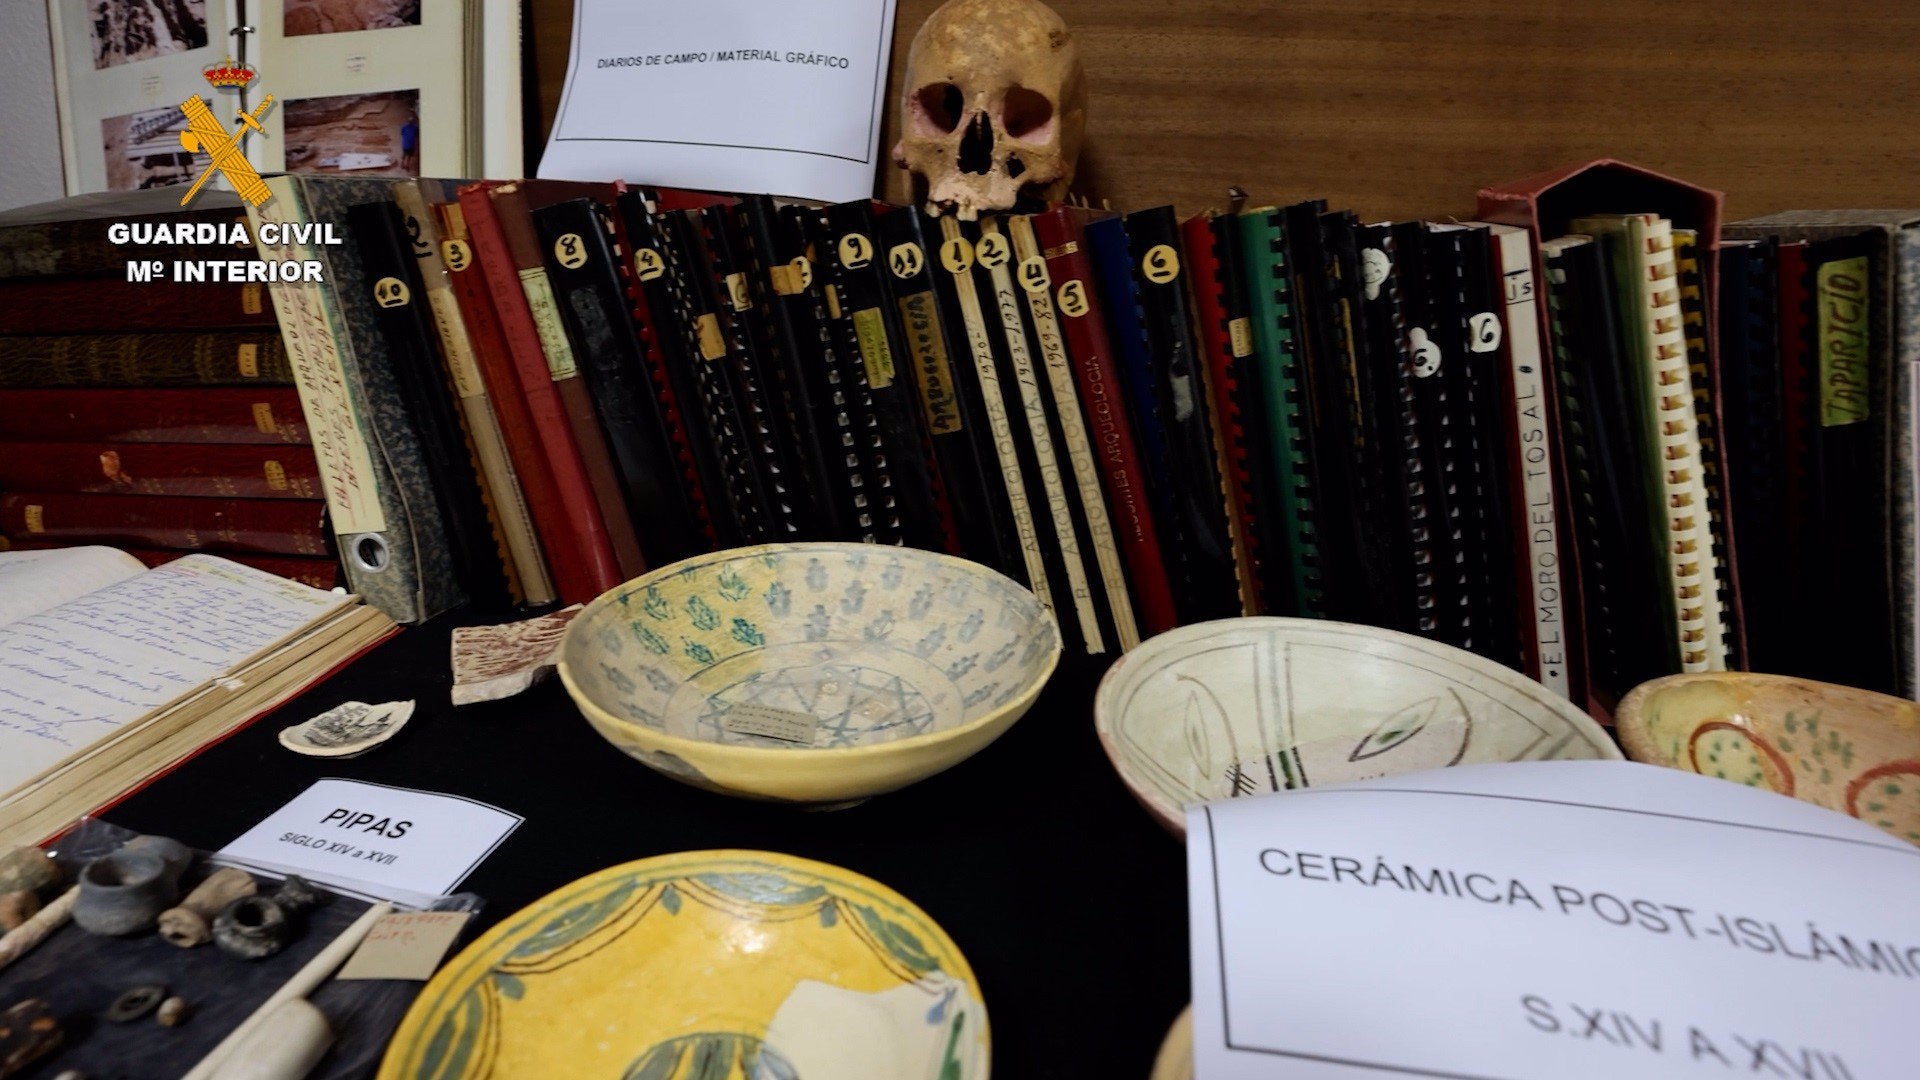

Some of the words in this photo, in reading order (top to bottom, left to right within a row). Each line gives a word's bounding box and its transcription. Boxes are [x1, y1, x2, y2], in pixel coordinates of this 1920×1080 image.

[597, 55, 643, 69] DIARIOS
[645, 54, 661, 67] DE
[663, 51, 708, 67] CAMPO
[716, 49, 782, 64] MATERIAL
[785, 49, 850, 70] GRÁFICO
[450, 243, 463, 263] 3
[561, 236, 577, 256] 8
[847, 237, 862, 259] 9
[982, 239, 1004, 259] 2
[1150, 250, 1167, 268] 6
[1062, 283, 1080, 307] 5
[1479, 317, 1495, 344] 6
[1532, 491, 1554, 545] DEL
[1538, 550, 1560, 624] MORO
[320, 807, 413, 841] PIPAS
[278, 831, 327, 851] SIGLO
[325, 841, 351, 857] XIV
[353, 849, 362, 859] a
[364, 850, 399, 867] XVII
[1259, 846, 1544, 912] CERÁMICA
[1690, 1026, 1732, 1068] A
